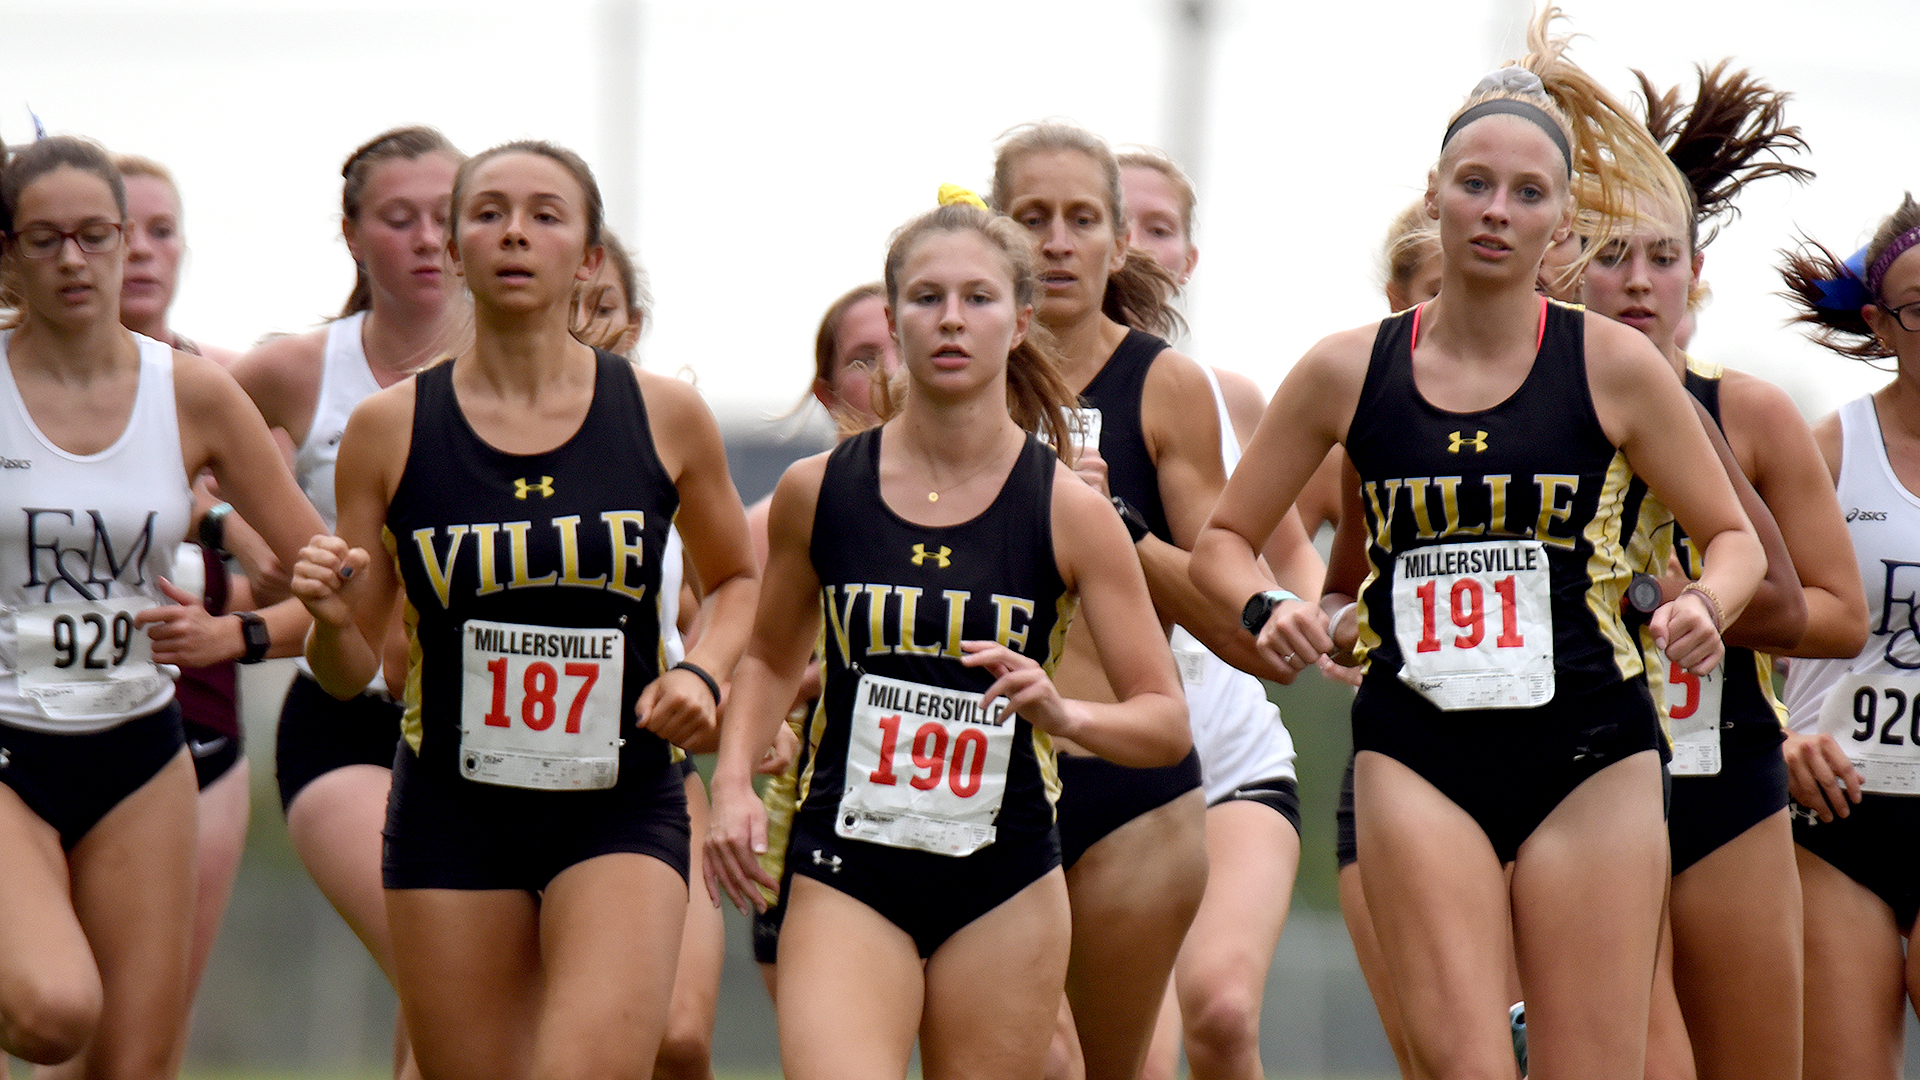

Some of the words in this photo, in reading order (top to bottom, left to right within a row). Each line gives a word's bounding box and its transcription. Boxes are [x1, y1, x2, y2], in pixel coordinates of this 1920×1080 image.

[1364, 473, 1580, 554] VILLE
[1859, 511, 1887, 521] asics
[413, 510, 645, 609] VILLE
[1405, 548, 1537, 578] MILLERSVILLE
[54, 611, 134, 669] 929
[474, 627, 613, 659] MILLERSVILLE
[825, 583, 1034, 668] VILLE
[1416, 575, 1524, 653] 191
[484, 656, 600, 734] 187
[867, 683, 1004, 727] MILLERSVILLE
[869, 714, 988, 798] 190
